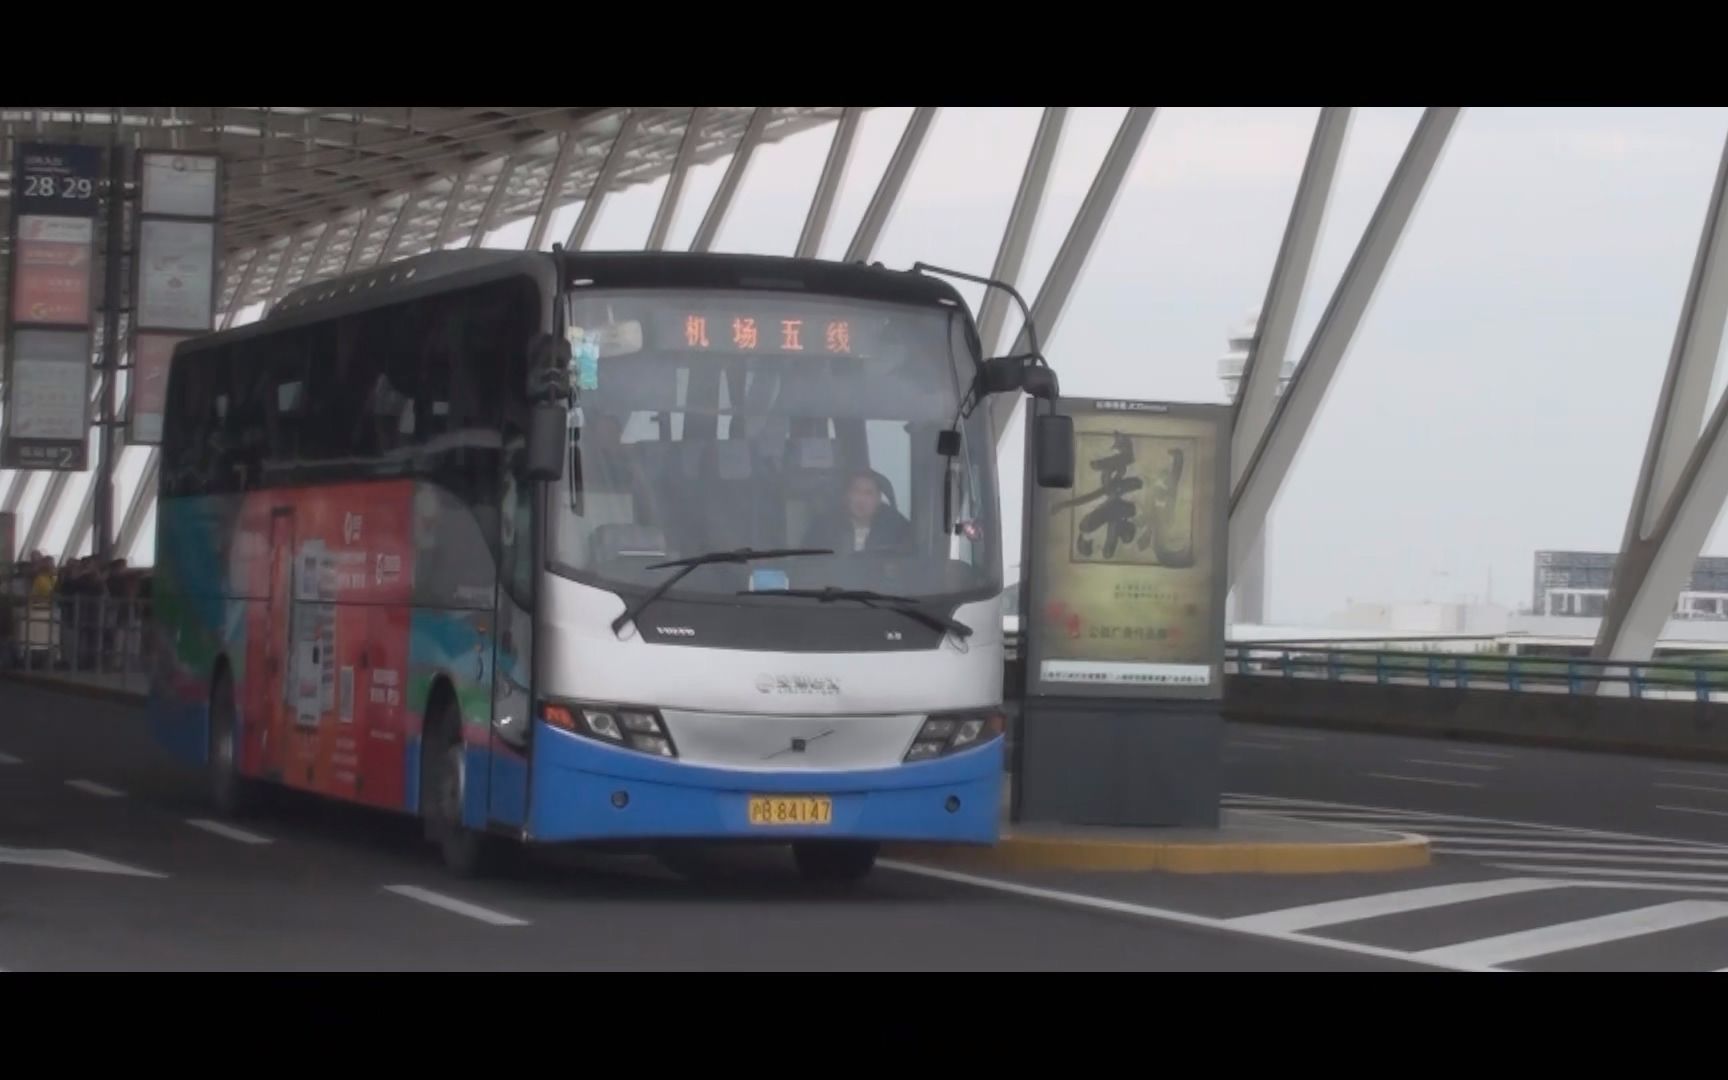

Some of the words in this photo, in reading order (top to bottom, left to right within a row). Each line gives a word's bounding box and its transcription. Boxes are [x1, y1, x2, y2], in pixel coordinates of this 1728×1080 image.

[24, 175, 54, 197] 28
[62, 176, 92, 199] 29
[685, 314, 851, 353] 机场五线
